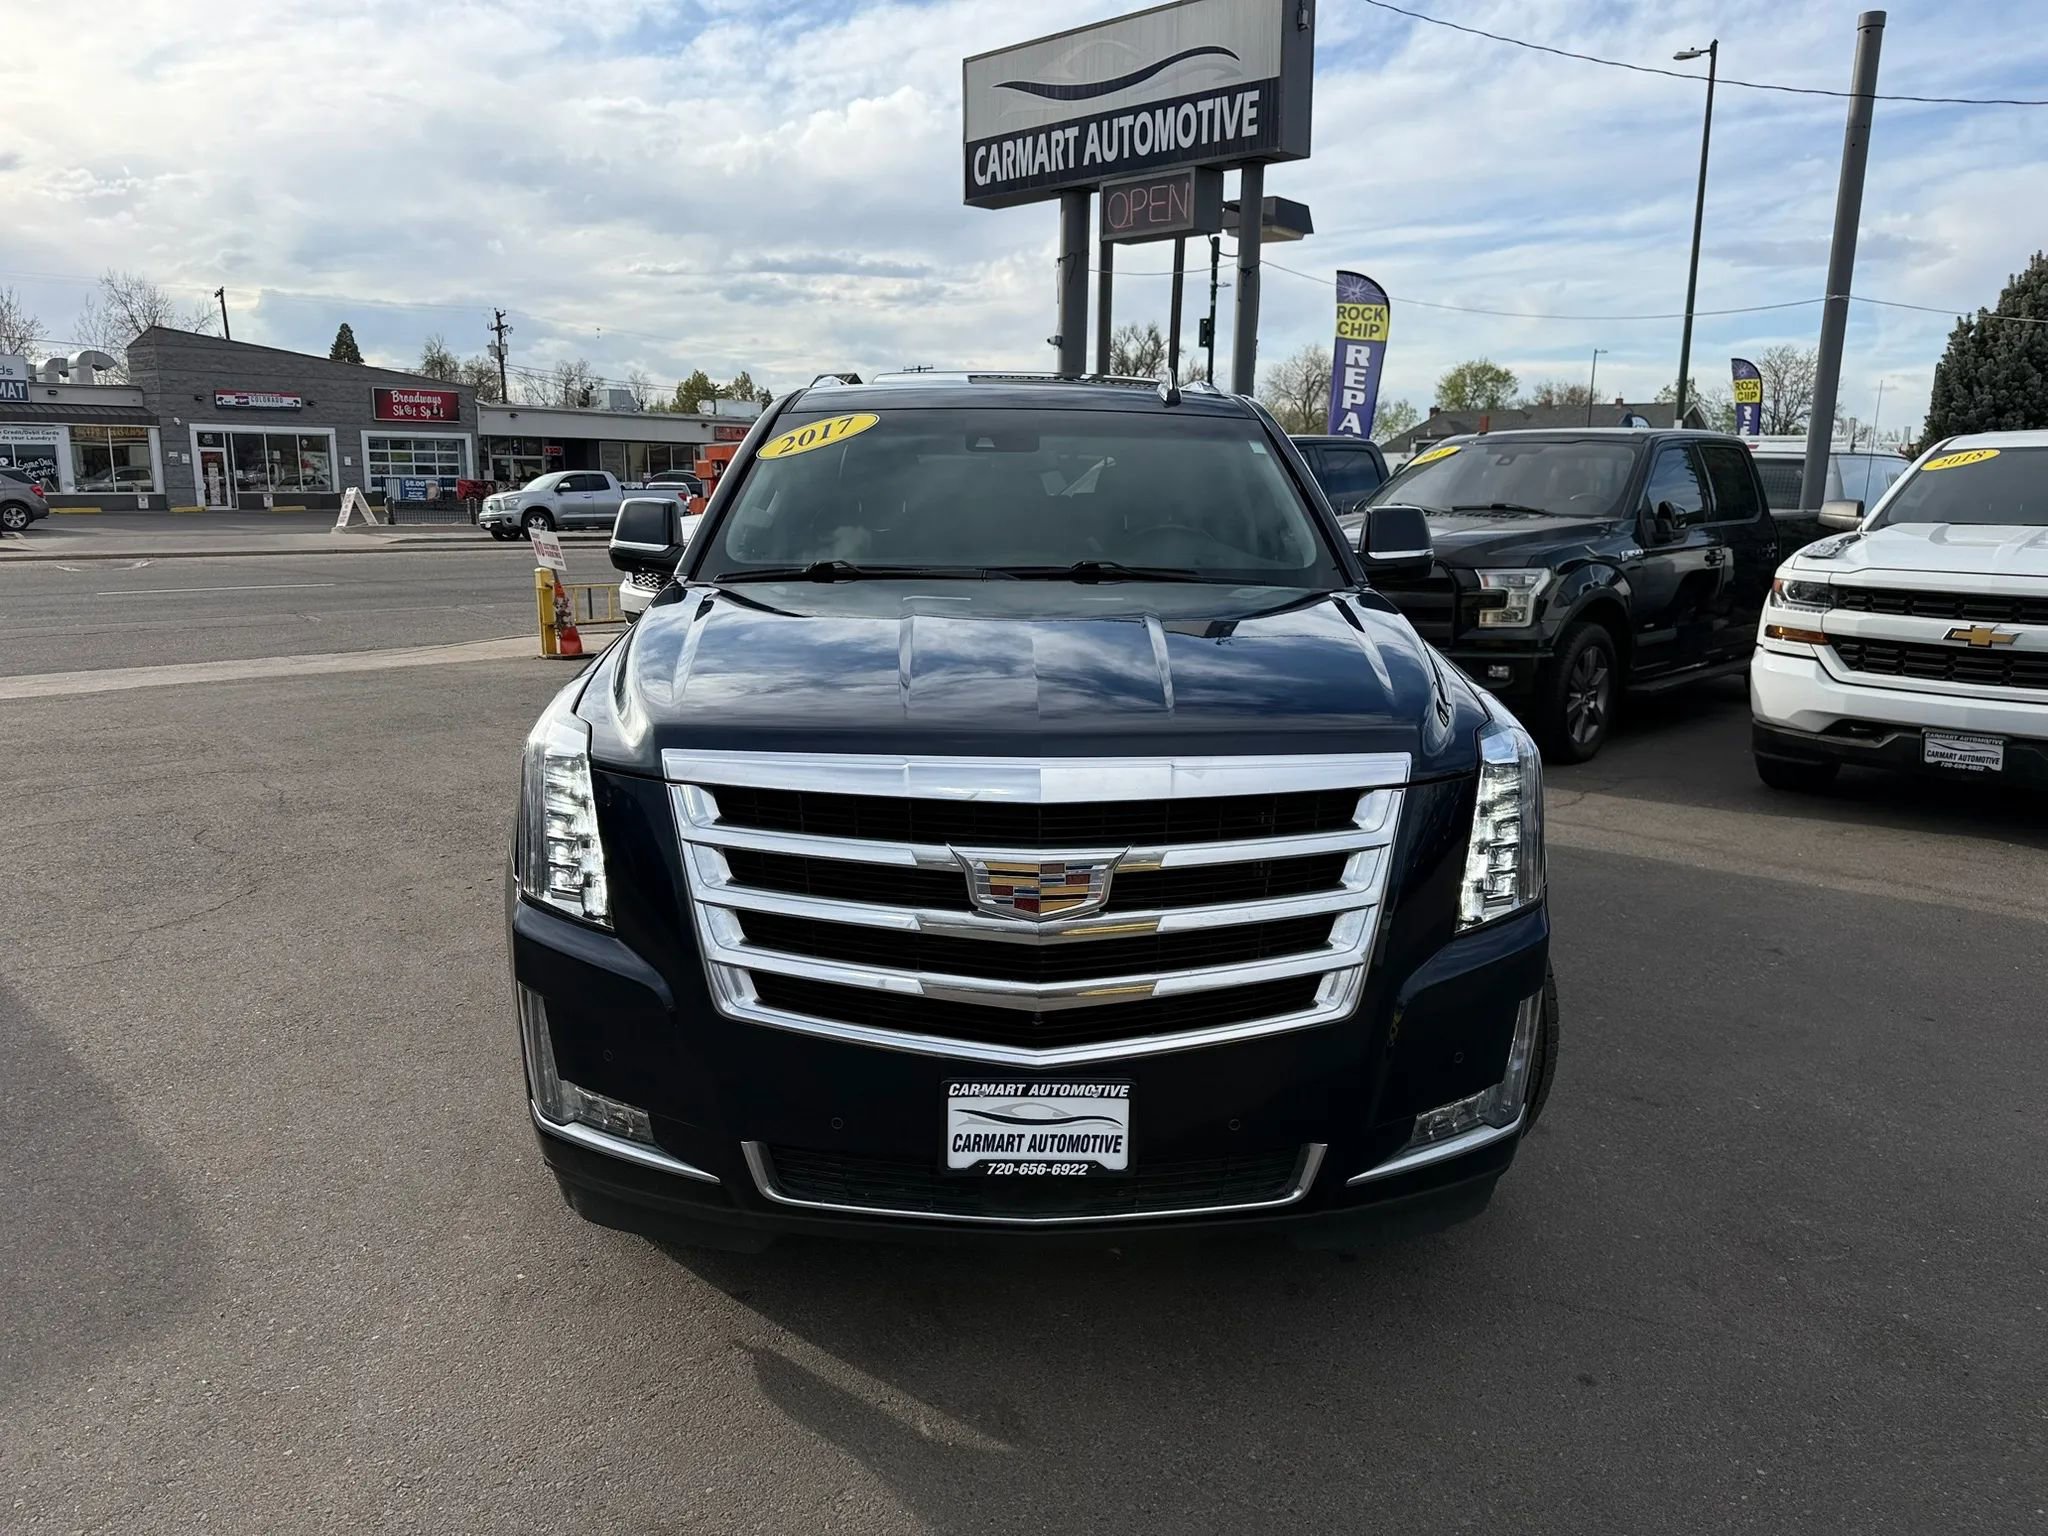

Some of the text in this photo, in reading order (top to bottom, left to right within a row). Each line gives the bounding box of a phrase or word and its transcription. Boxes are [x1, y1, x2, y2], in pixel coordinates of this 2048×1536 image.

[973, 89, 1261, 186] CARMART AUTOMOTIVE
[1107, 181, 1191, 229] OPEN
[1336, 305, 1385, 322] ROCK
[1337, 321, 1381, 338] CHIP
[1735, 381, 1759, 391] ROCK
[250, 395, 284, 404] COLORADO
[391, 390, 442, 406] Broadways
[778, 416, 855, 455] 2017
[1935, 450, 1987, 468] 2018
[1925, 732, 1959, 740] CARMART
[1926, 749, 2000, 765] CARMART AUTOMOTIVE
[949, 1084, 1130, 1097] CARMART AUTOMOTIVE
[952, 1133, 1123, 1154] CARMART AUTOMOTIVE
[986, 1162, 1088, 1176] 720-656-6922
